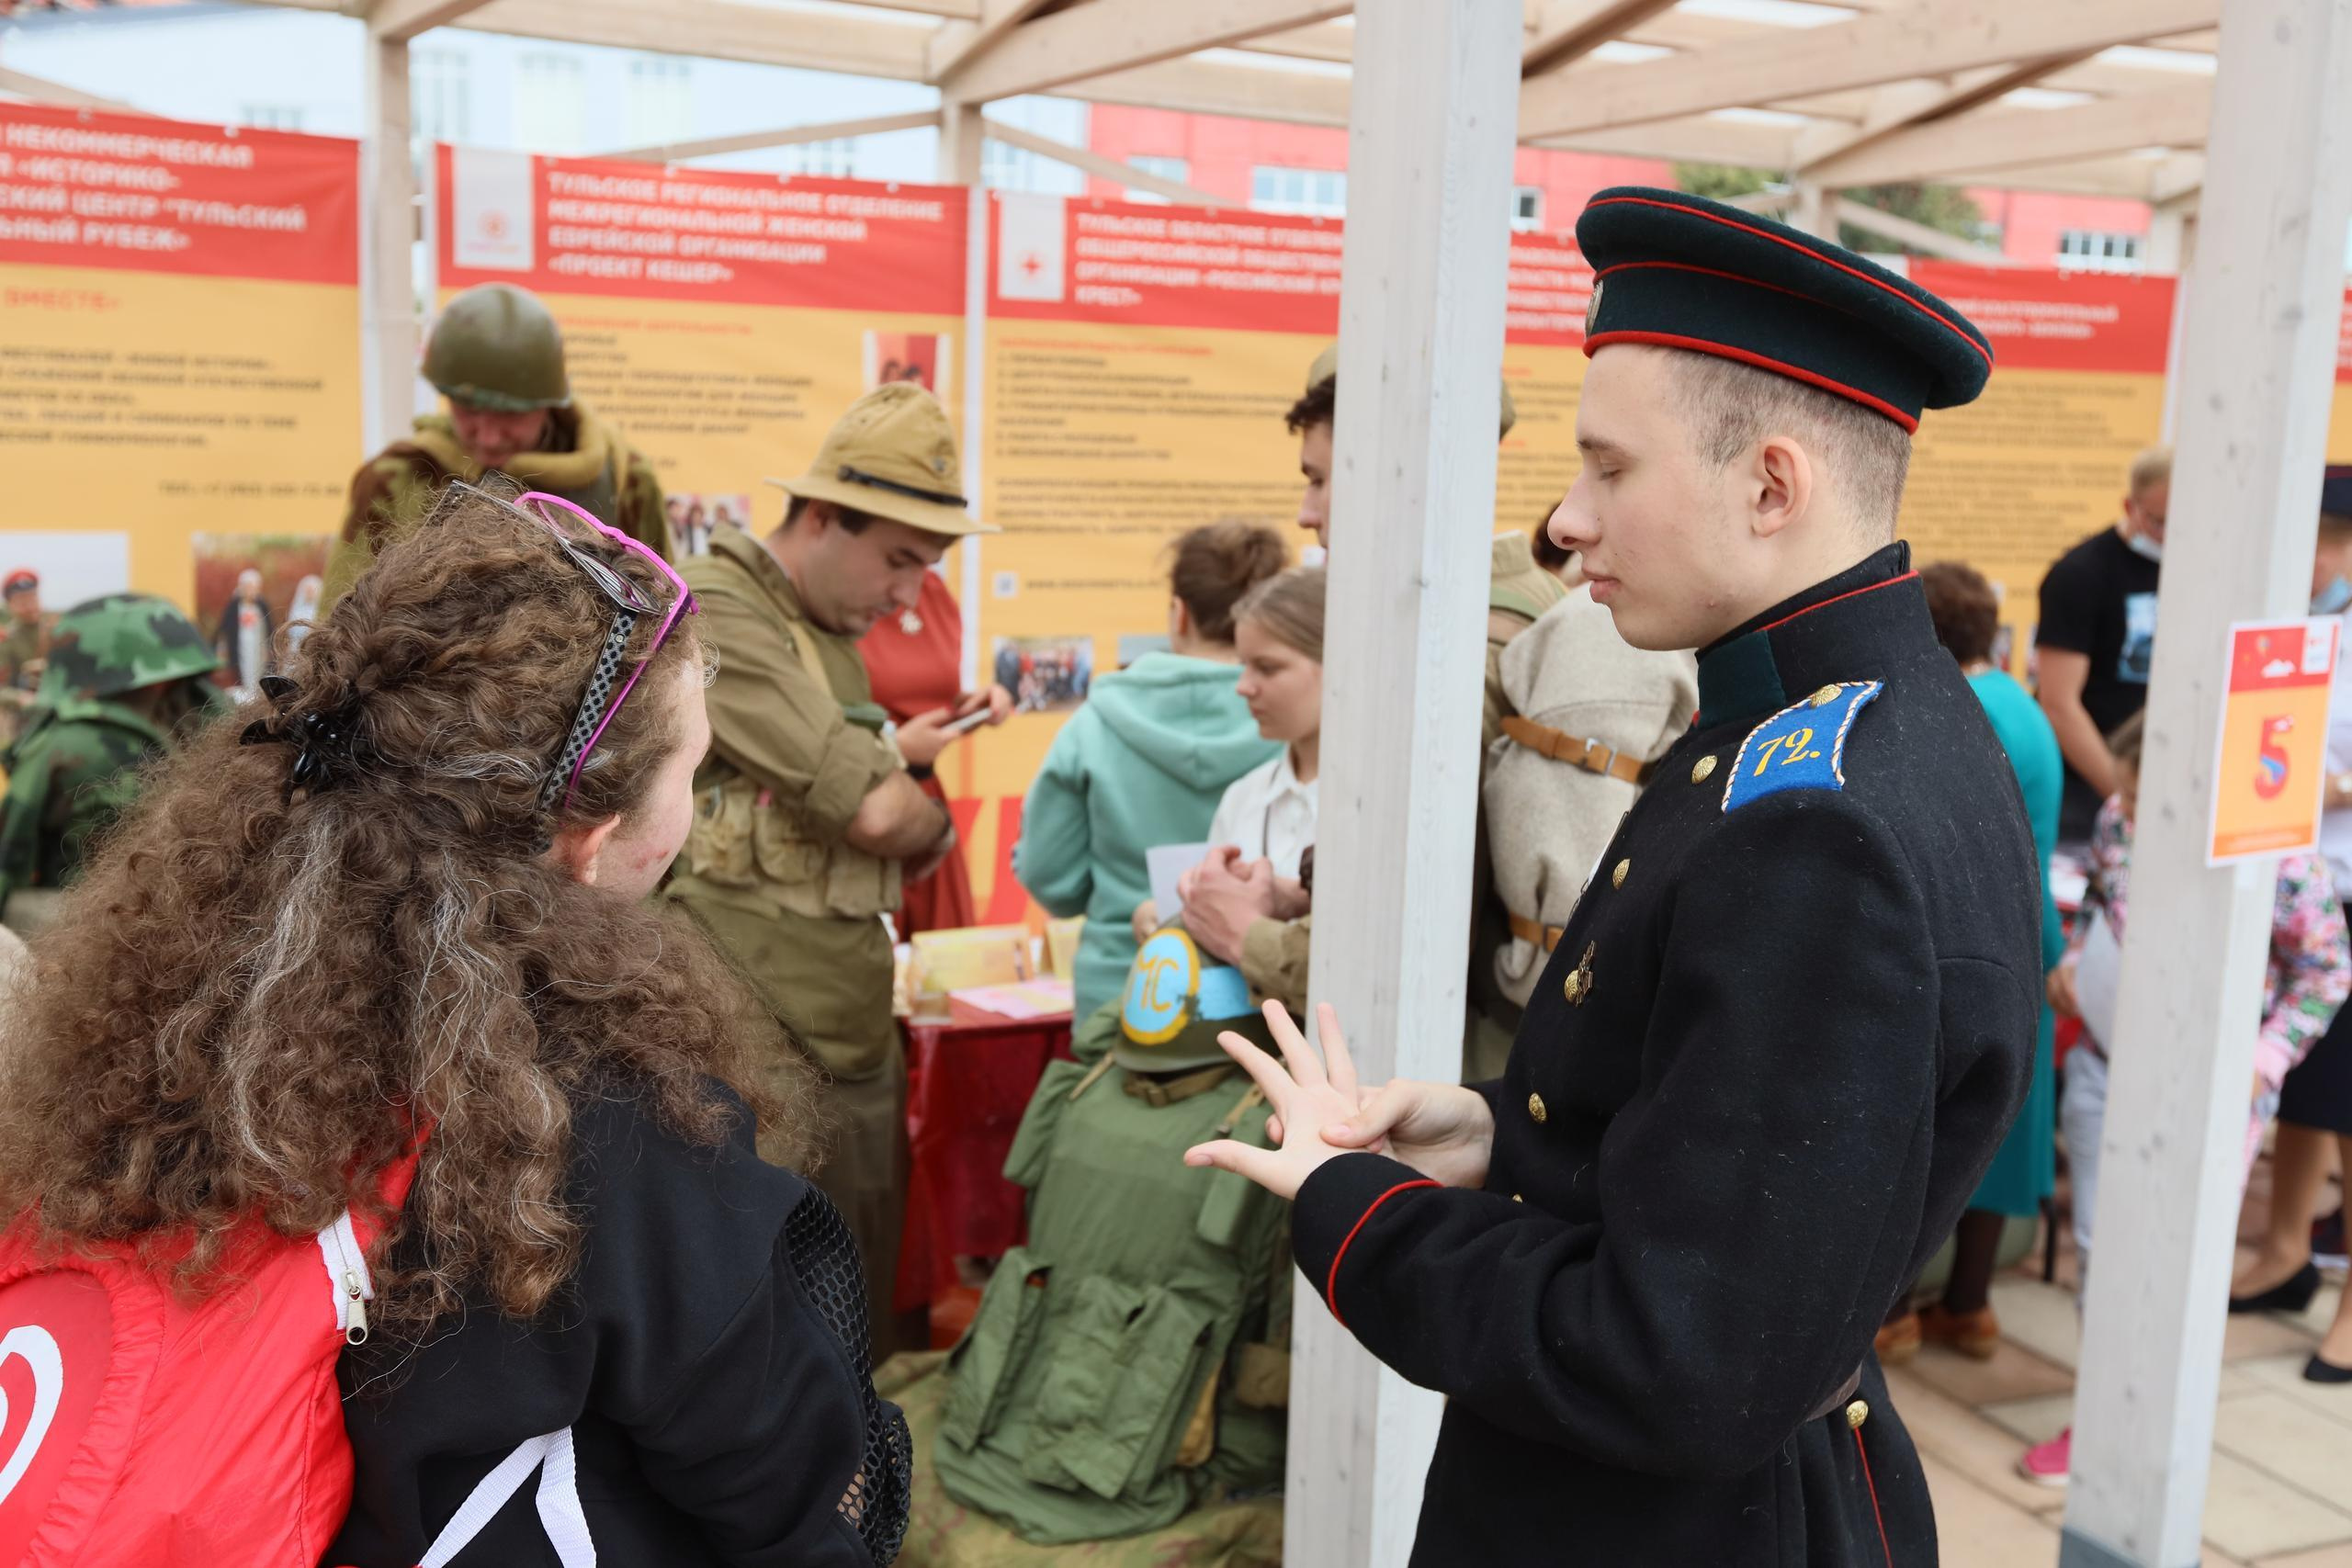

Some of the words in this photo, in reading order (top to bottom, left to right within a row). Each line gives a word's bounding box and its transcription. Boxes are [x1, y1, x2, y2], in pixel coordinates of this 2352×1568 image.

[6, 123, 254, 169] НЕКОММЕРЧЕСКАЯ
[73, 189, 160, 219] ЦЕНТР
[548, 171, 659, 203] ТУЛЬСКОЕ
[661, 181, 823, 214] РЕГИОНАЛЬНОЕ
[826, 193, 944, 222] ОТДЕЛЕНИЕ
[548, 198, 764, 233] МЕЖРЕГИОНАЛЬНОЙ
[767, 216, 868, 243] ЖЕНСКОЙ
[548, 225, 676, 255] ЕВРЕЙСКОЙ
[678, 234, 827, 265] ОРГАНИЗАЦИИ
[2253, 716, 2294, 802] 5
